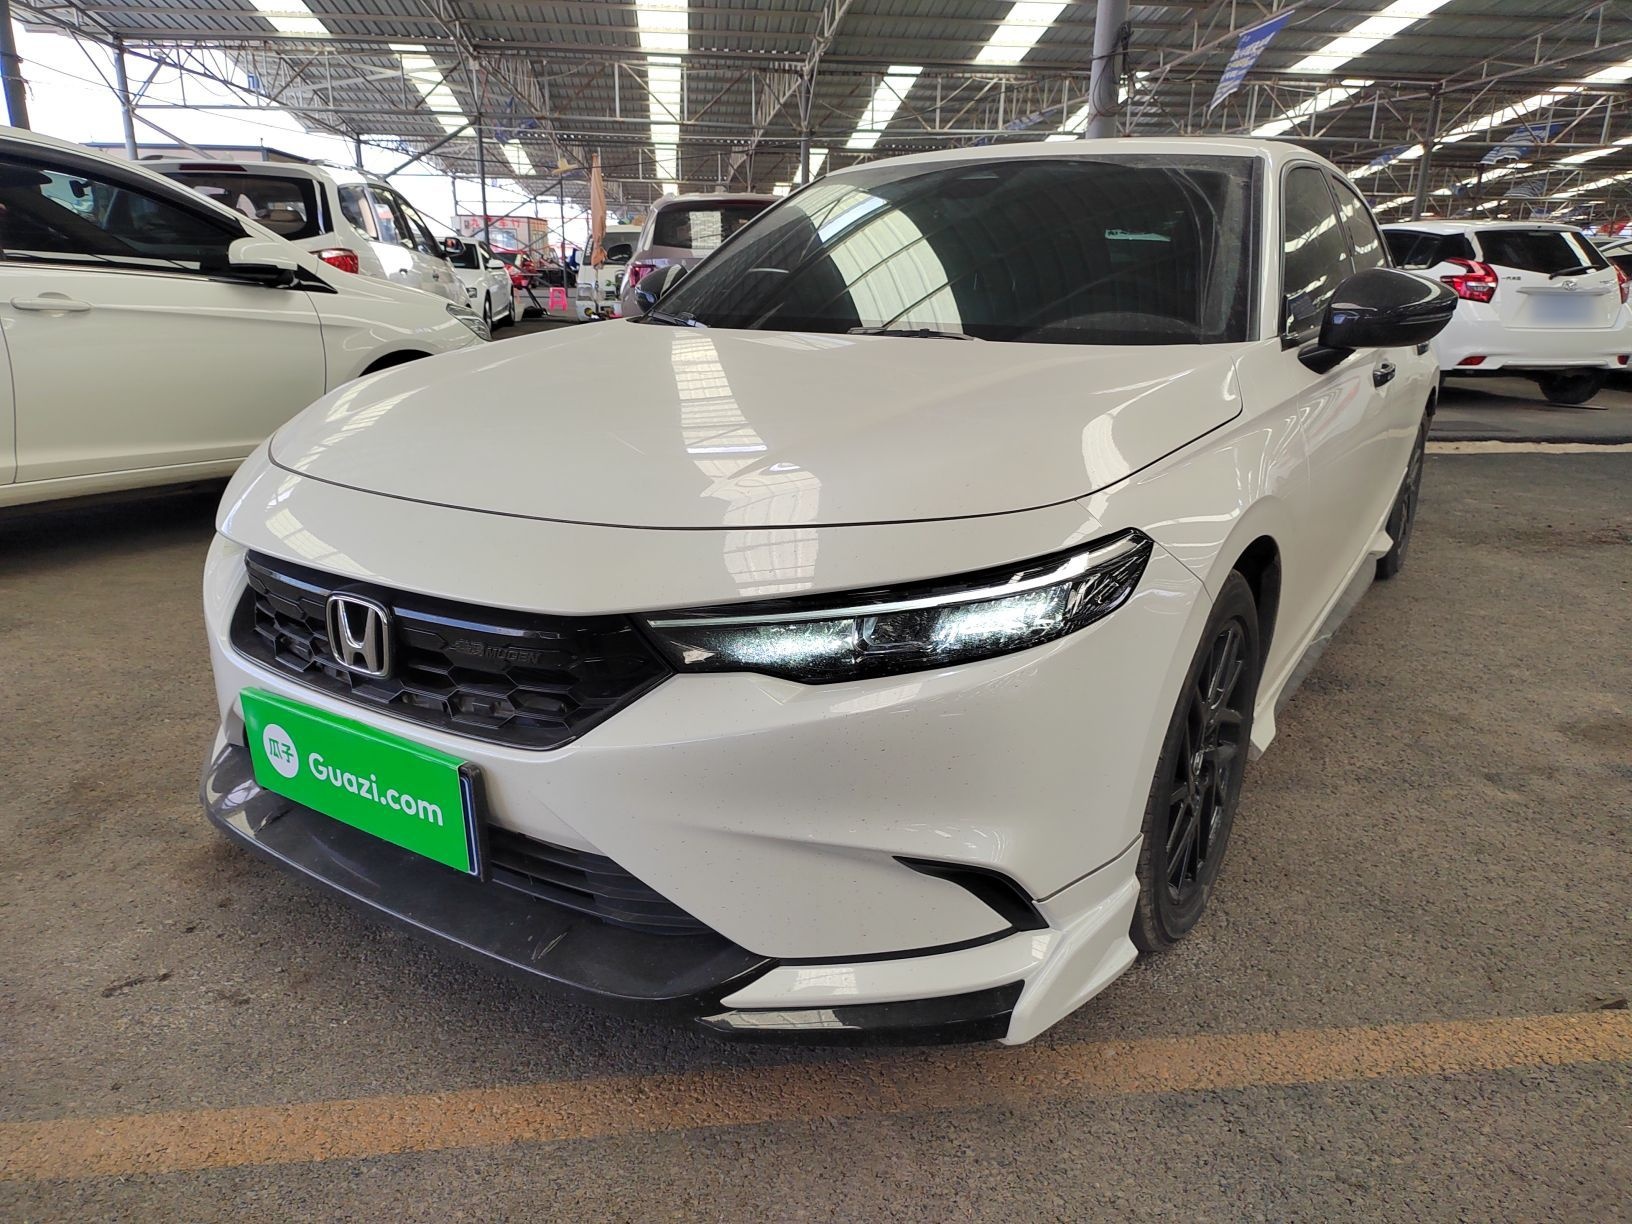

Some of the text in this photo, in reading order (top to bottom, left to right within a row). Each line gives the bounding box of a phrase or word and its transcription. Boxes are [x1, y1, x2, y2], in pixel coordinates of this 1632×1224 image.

[485, 646, 541, 664] MUGEN
[269, 737, 294, 763] 瓜子
[308, 752, 444, 827] Guazi.com
